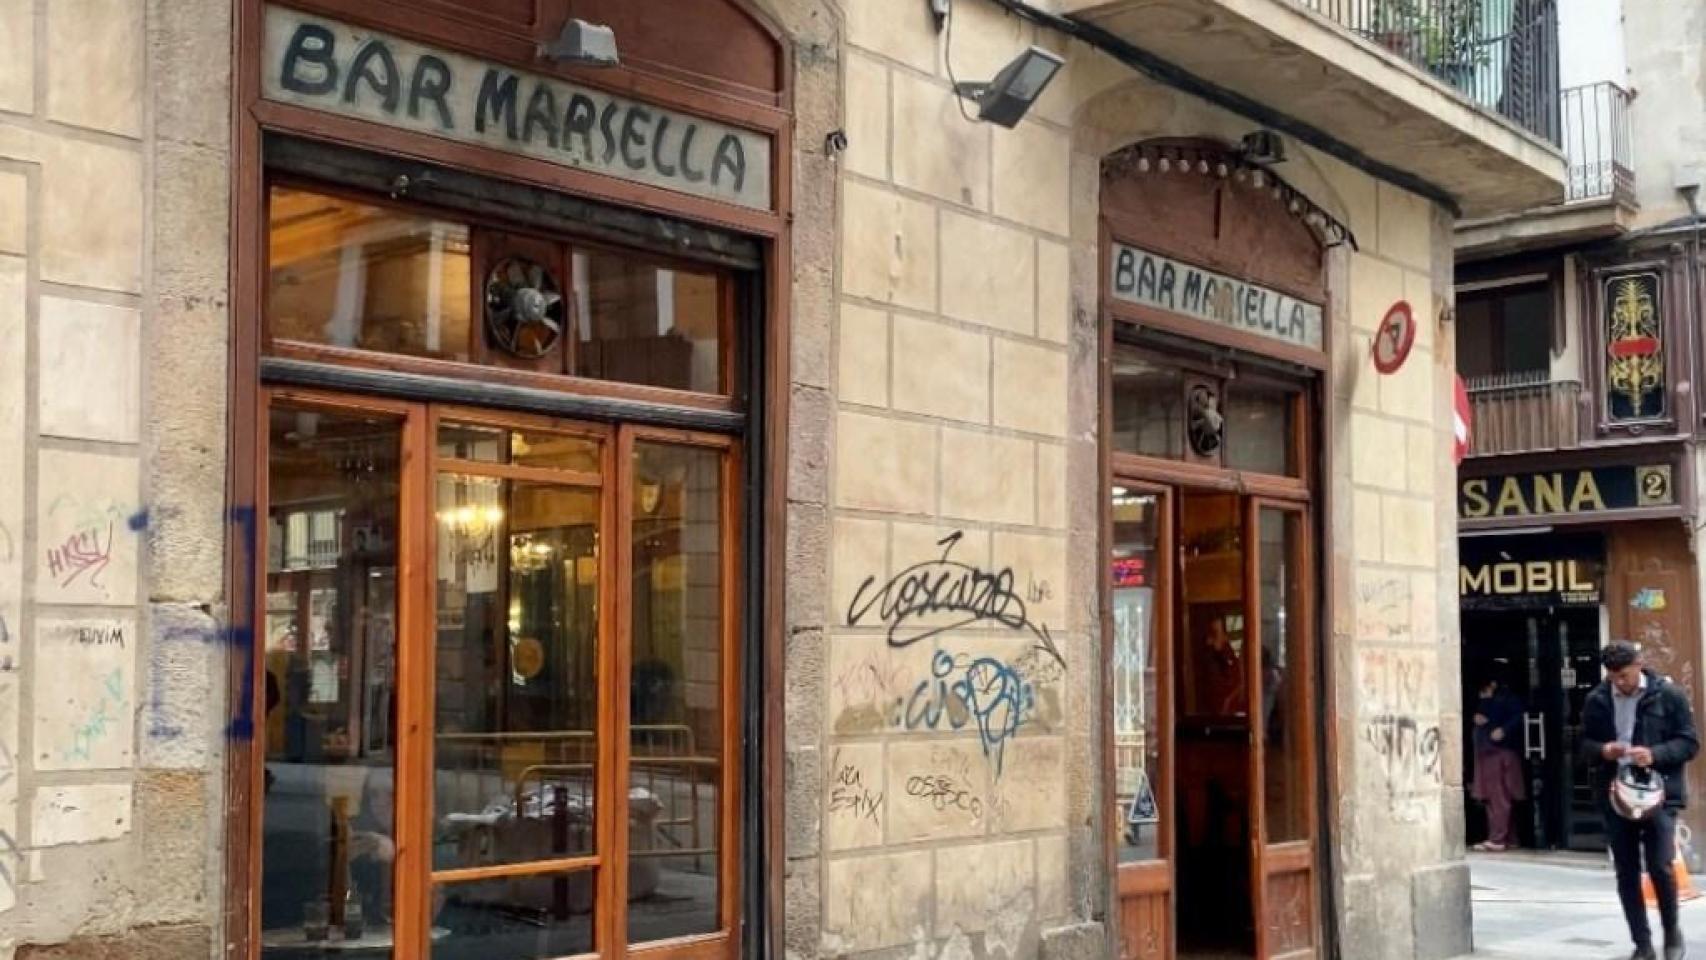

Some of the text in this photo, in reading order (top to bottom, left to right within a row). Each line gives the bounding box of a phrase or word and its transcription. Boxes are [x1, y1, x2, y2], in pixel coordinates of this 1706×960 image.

[281, 24, 747, 193] BAR MARSELLA
[1115, 247, 1176, 310] BAR
[1462, 470, 1607, 518] SANA
[1645, 473, 1664, 497] 2
[1460, 551, 1594, 595] MÒBIL
